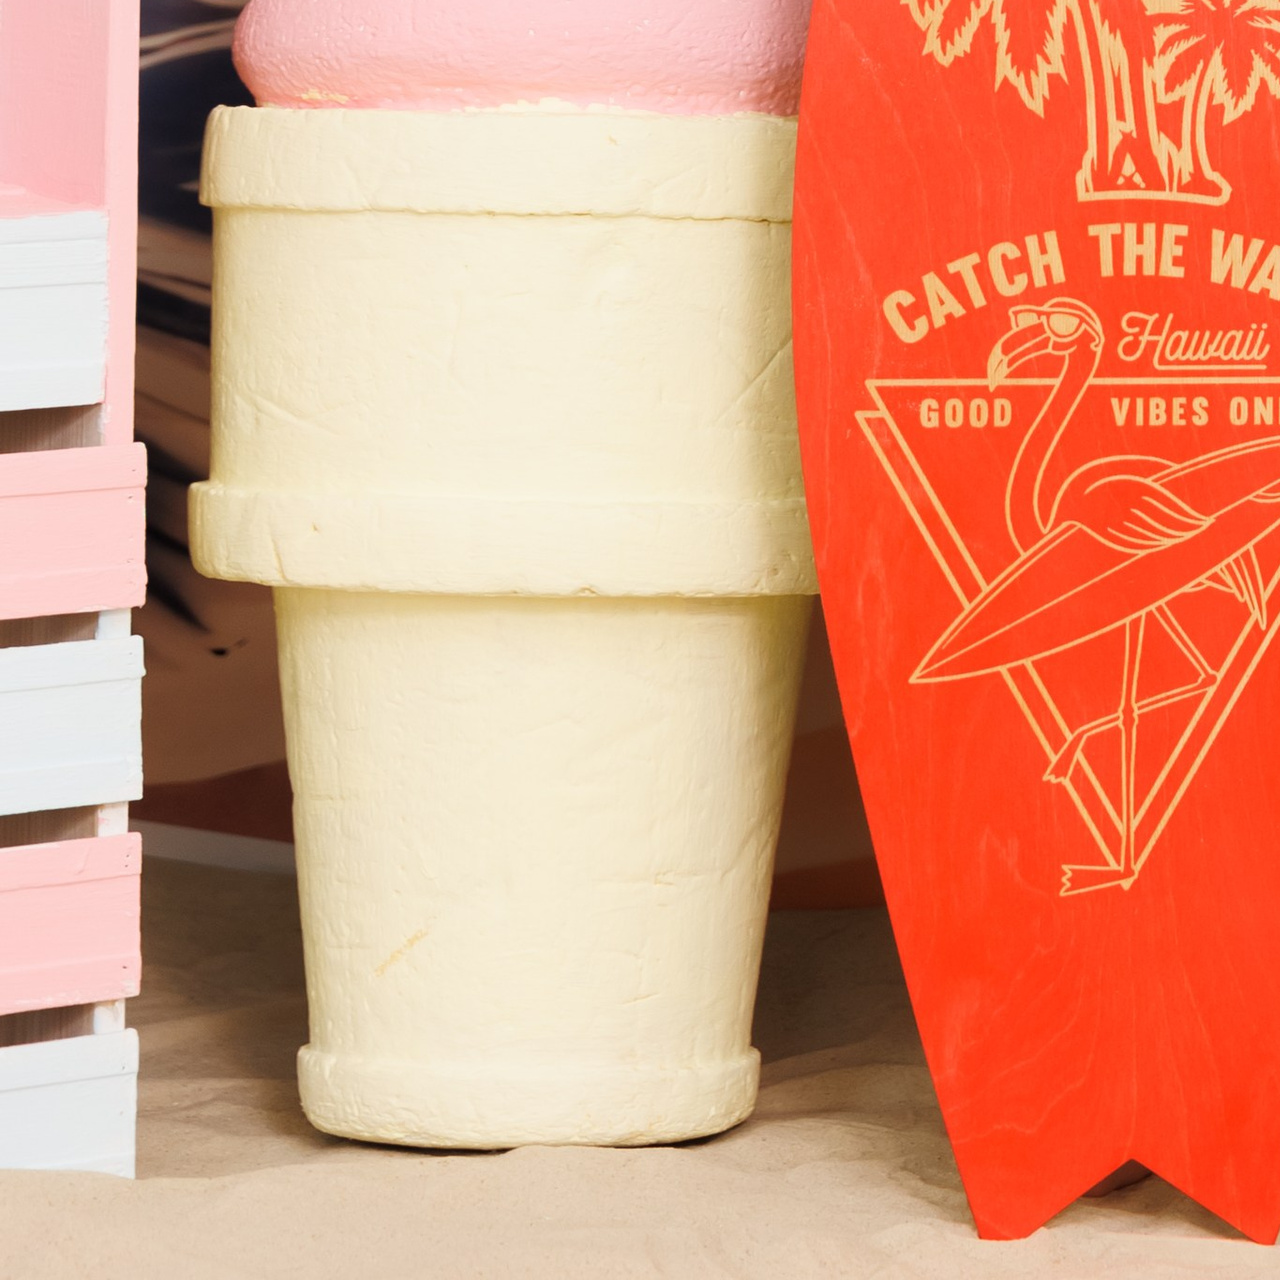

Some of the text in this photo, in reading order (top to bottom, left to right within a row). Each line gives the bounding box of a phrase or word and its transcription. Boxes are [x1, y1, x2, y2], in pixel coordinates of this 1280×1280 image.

[882, 230, 1066, 344] CATCH
[1087, 222, 1189, 278] THE
[1117, 311, 1271, 370] Hawaii
[919, 397, 1012, 429] GOOD
[1110, 396, 1209, 427] VIBES
